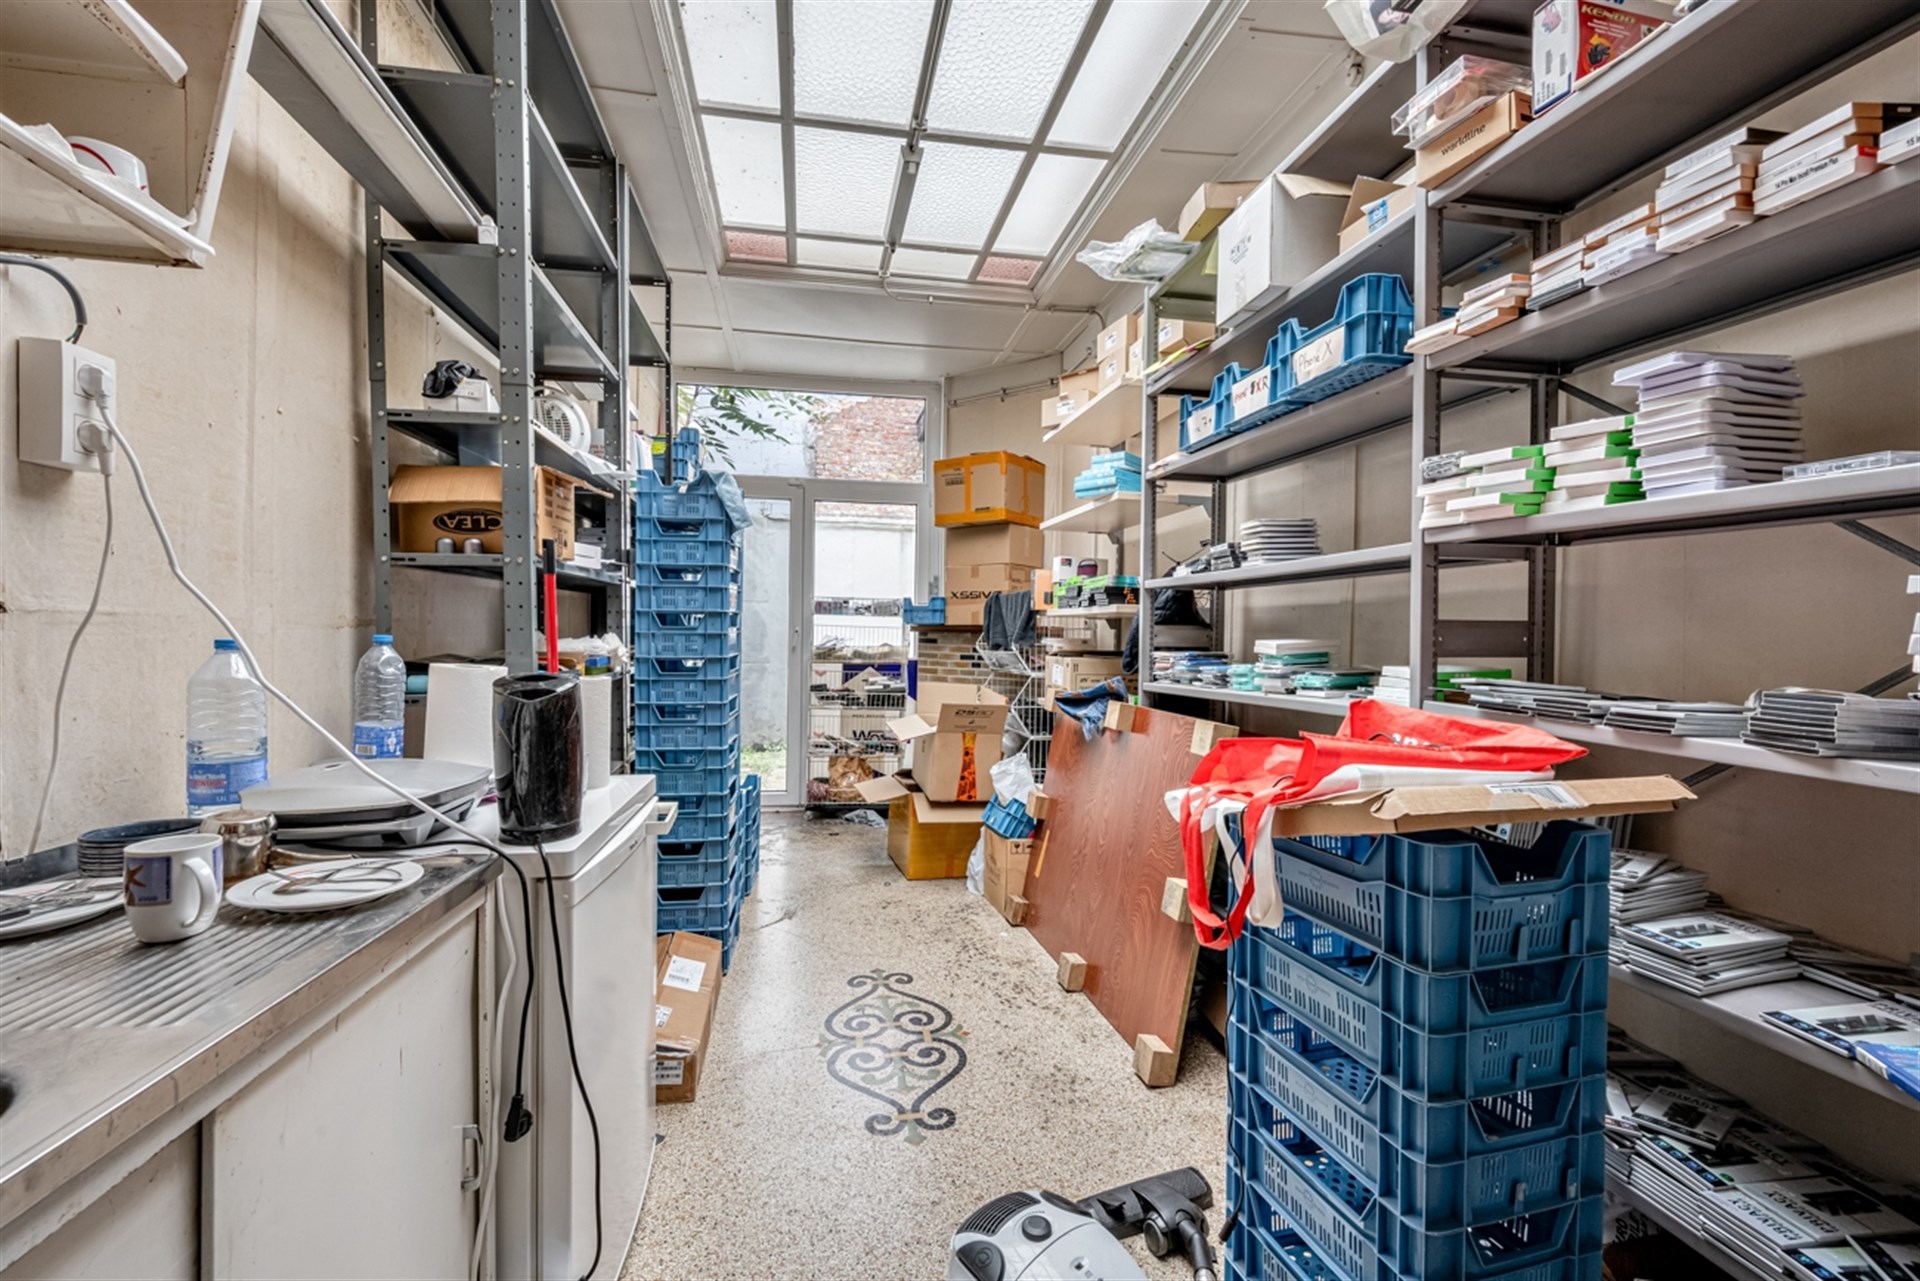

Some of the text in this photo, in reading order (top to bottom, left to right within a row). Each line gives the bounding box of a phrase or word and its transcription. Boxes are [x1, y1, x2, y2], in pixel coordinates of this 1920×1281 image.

[1581, 4, 1636, 24] KENDO
[1441, 124, 1486, 156] worldline
[1727, 1197, 1802, 1242] PRIVACY
[1763, 1190, 1840, 1234] PRIVACY
